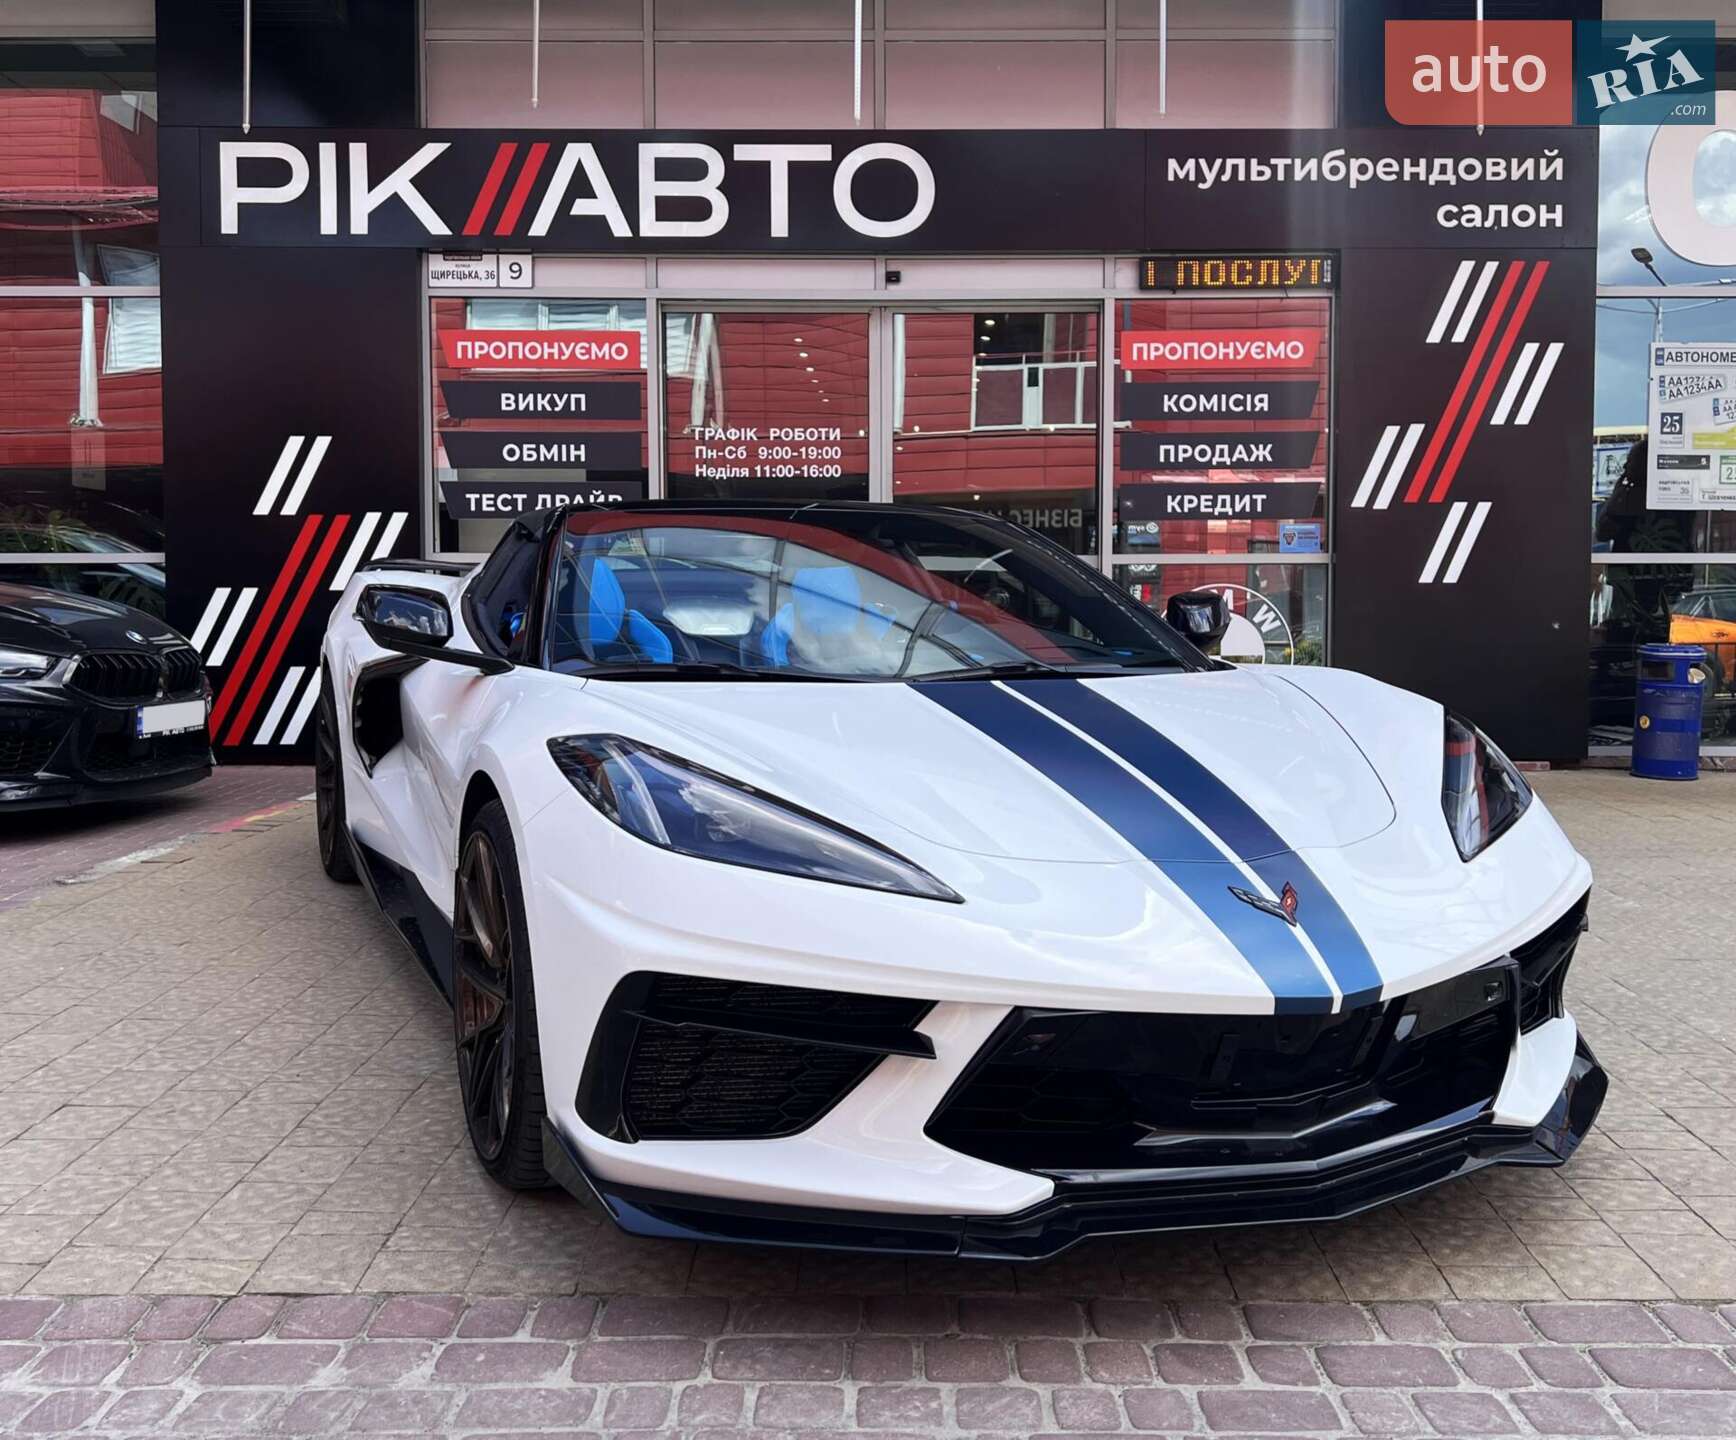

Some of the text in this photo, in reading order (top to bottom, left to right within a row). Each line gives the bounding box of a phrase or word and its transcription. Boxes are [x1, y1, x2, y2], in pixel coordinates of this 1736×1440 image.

[1166, 148, 1564, 190] мультибрендовий
[1436, 203, 1563, 229] салон
[508, 261, 523, 280] 9
[456, 341, 629, 360] ПРОПОНУЄМО
[1132, 341, 1304, 361] ПРОПОНУЄМО
[500, 393, 586, 412] ВИКУП
[1163, 393, 1269, 413] КОМІСІЯ
[1662, 415, 1680, 433] 25
[694, 428, 841, 441] ГРАФІК РОБОТИ
[502, 444, 586, 462] ОБМІН
[695, 446, 842, 459] Пн-Сб 9:00-19:00
[1159, 444, 1273, 465] ПРОДАЖ
[695, 464, 842, 480] Неділя 11:00-16:00
[465, 493, 527, 512] ТЕСТ
[1166, 494, 1267, 515] КРЕДИТ
